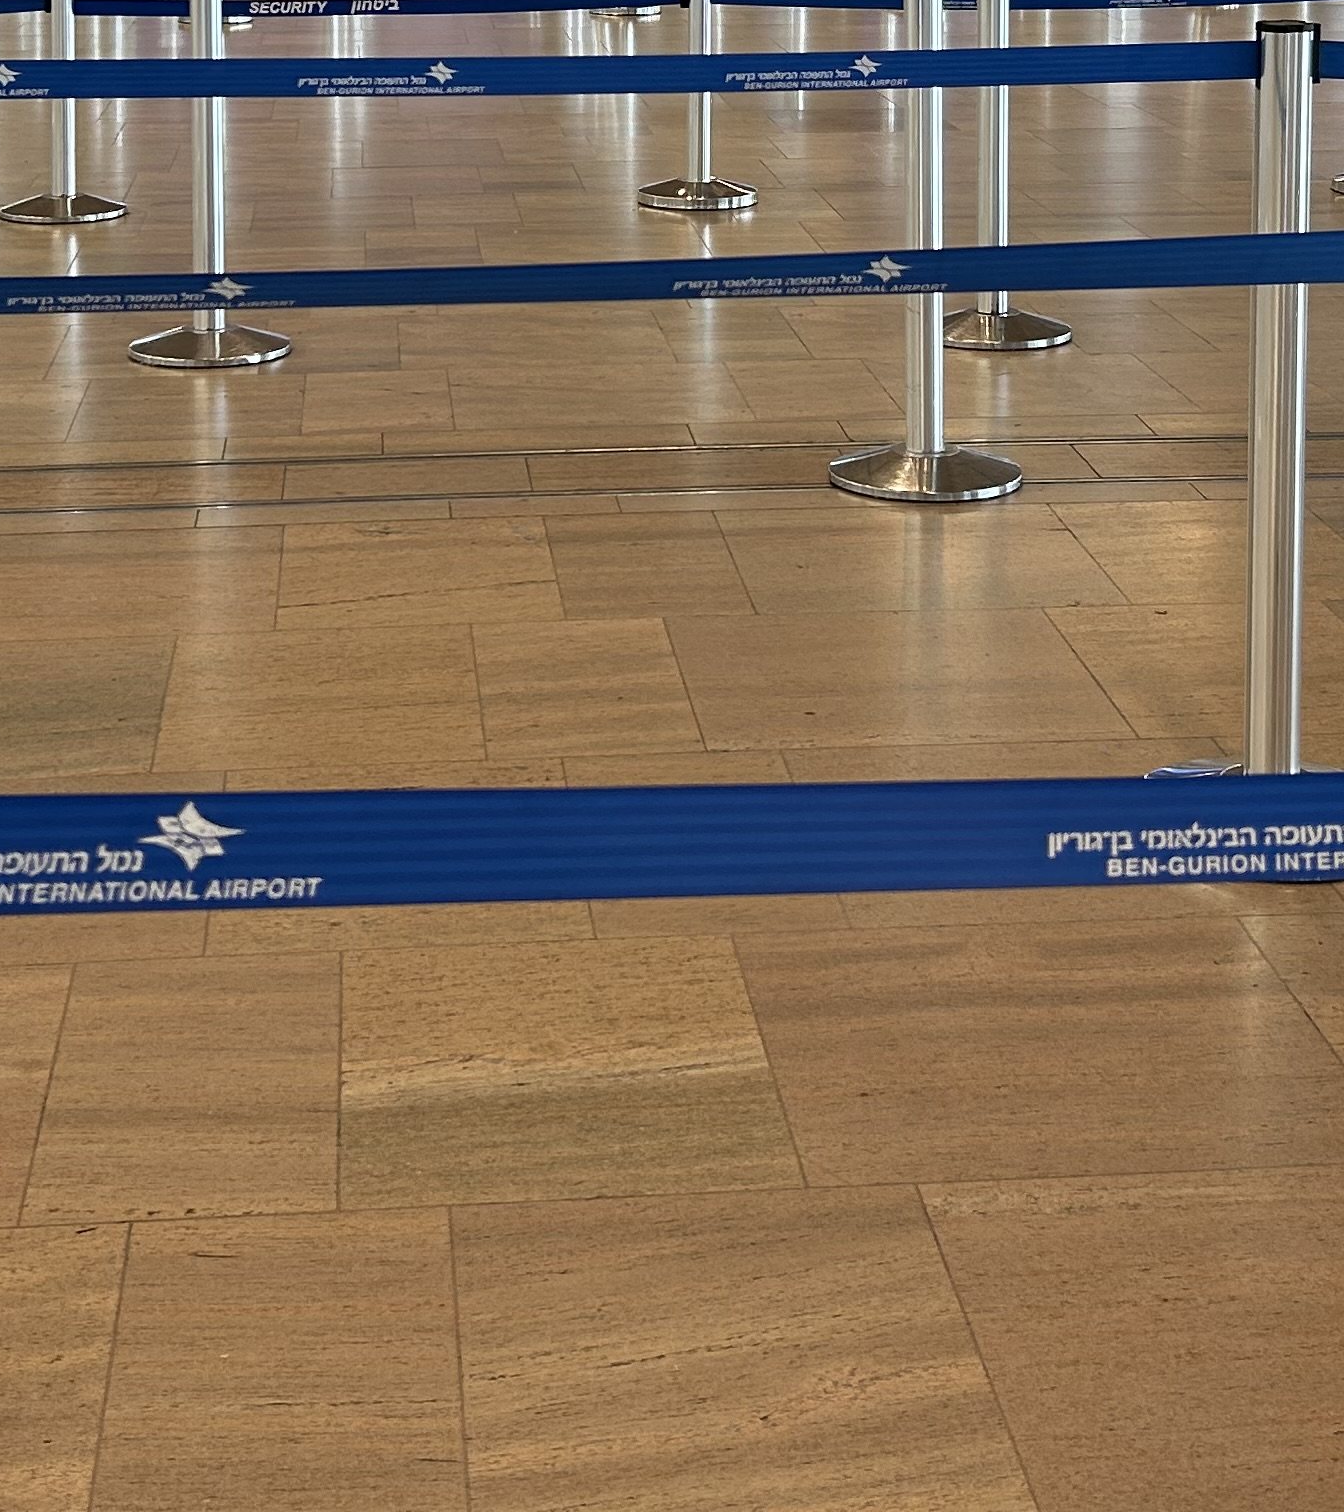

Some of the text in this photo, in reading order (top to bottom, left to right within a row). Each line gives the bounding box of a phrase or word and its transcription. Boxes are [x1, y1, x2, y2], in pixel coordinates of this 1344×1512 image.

[249, 1, 328, 14] SECURITY
[350, 0, 400, 14] ביטחון
[1140, 820, 1257, 850] הבינלאומי
[97, 844, 145, 872] נמל
[1106, 853, 1267, 877] BEN-GURION
[203, 877, 324, 901] AIRPORT
